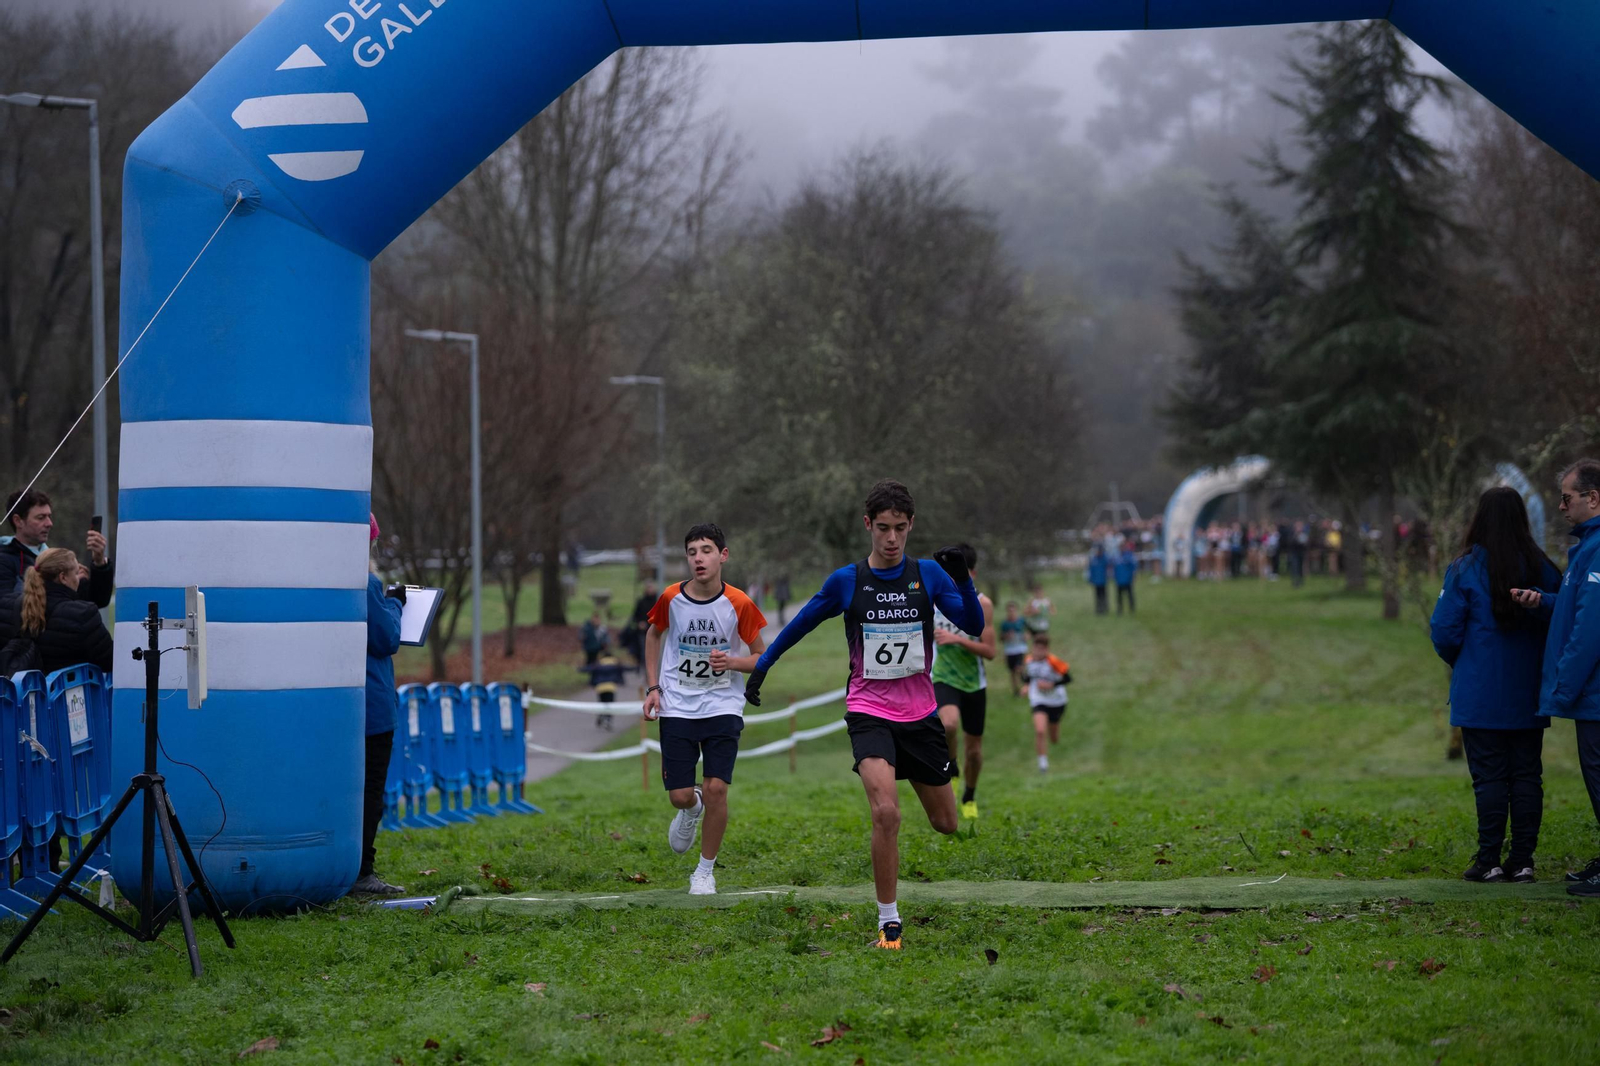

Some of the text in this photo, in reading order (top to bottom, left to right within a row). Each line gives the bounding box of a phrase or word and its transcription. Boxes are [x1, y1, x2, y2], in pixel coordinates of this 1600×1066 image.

[876, 592, 907, 602] CUPA
[866, 608, 919, 620] O BARCO
[688, 619, 715, 632] ANA
[875, 642, 910, 665] 67
